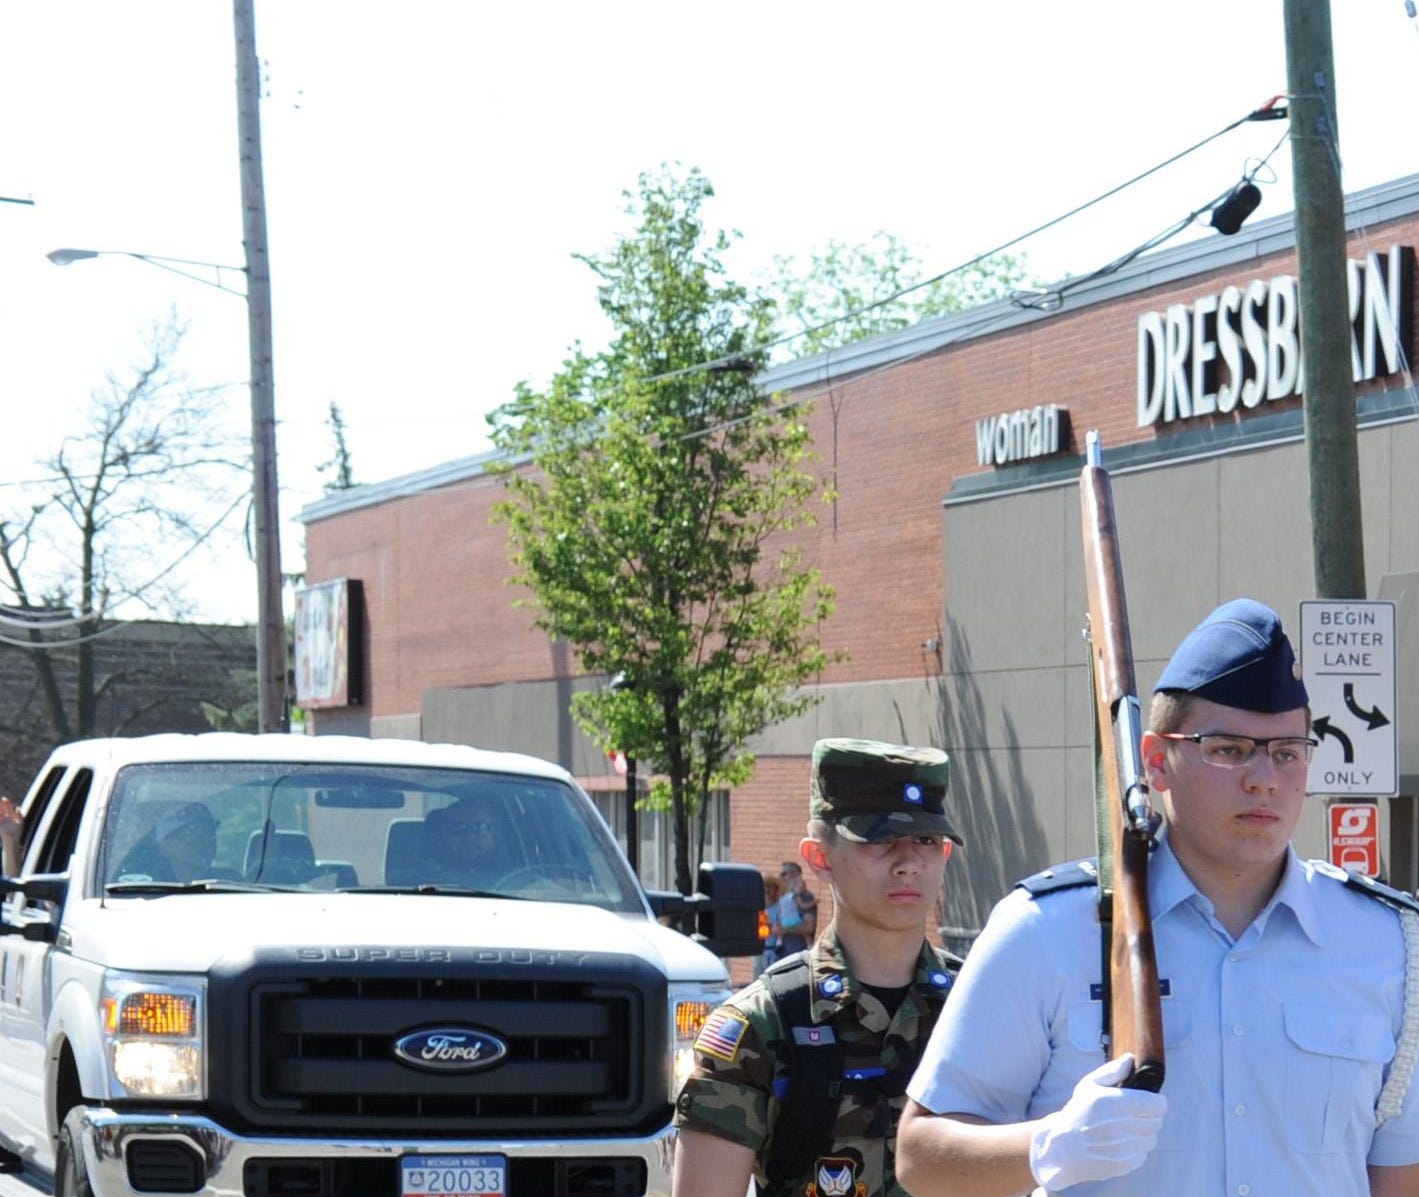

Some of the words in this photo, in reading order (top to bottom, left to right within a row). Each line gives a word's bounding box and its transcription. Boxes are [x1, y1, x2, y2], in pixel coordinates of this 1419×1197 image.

[1137, 245, 1403, 427] DRESSBRN
[975, 405, 1061, 465] woman
[1320, 611, 1375, 625] BEGIN
[1312, 632, 1383, 646] CENTER
[1324, 653, 1372, 667] LANE
[1324, 771, 1373, 786] ONLY
[297, 947, 452, 963] SUPER
[475, 950, 590, 965] DUTY
[421, 1035, 481, 1061] Ford
[427, 1158, 460, 1167] MICHIGAN
[428, 1170, 500, 1191] 20033
